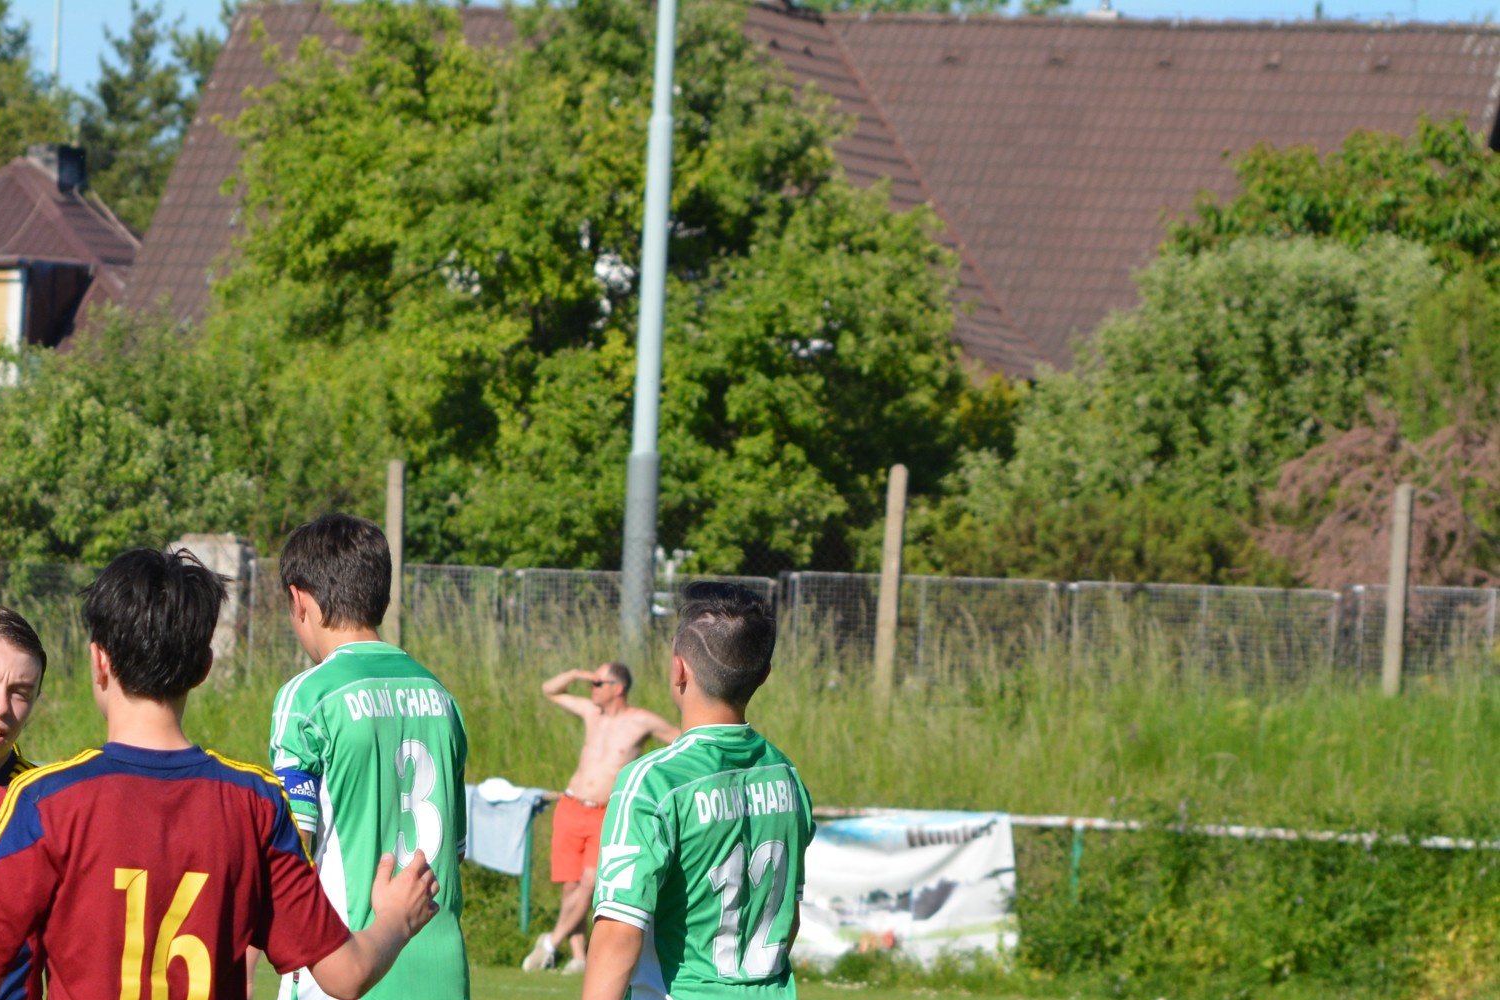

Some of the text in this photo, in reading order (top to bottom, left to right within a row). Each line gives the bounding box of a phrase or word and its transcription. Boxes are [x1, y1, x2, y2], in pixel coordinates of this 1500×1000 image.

[289, 786, 317, 799] adida
[394, 739, 443, 870] 3
[695, 780, 799, 824] DOLN CHAB
[708, 840, 789, 979] 12
